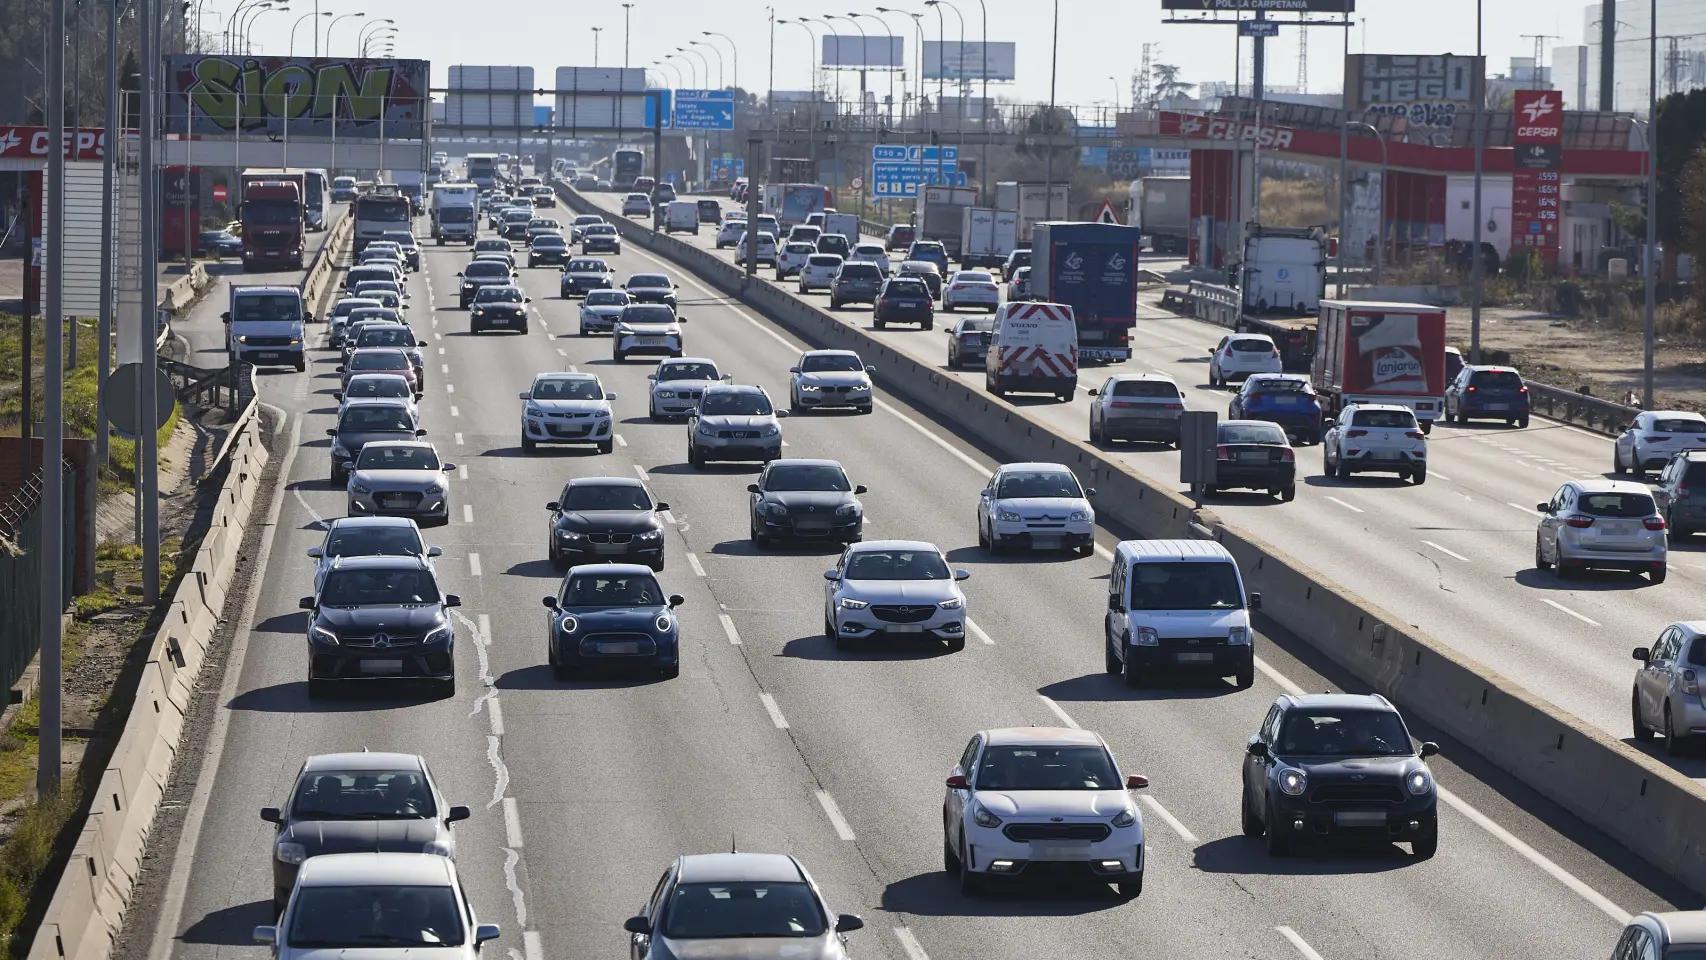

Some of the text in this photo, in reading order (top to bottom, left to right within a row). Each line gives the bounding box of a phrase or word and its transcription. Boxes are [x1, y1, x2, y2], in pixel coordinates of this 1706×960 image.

[1251, 0, 1308, 8] CARPETANIA
[1208, 121, 1294, 148] CEPSA
[1518, 127, 1558, 137] CEPSA
